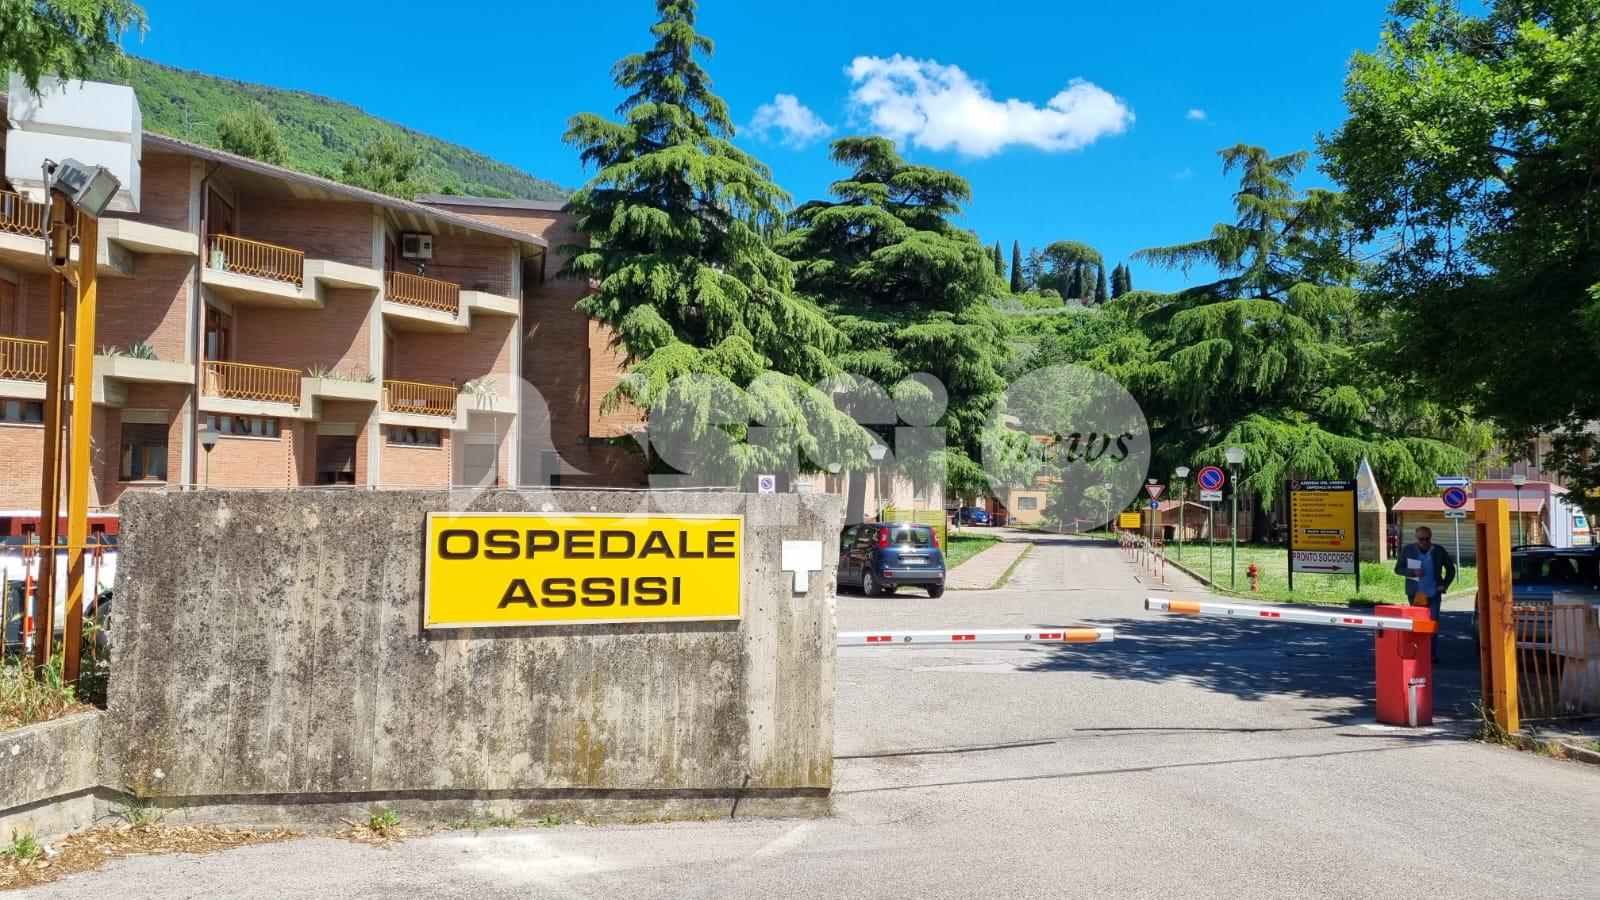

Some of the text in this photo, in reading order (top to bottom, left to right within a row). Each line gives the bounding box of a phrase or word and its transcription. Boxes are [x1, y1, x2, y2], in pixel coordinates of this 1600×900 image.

[437, 529, 736, 560] OSPEDALE
[1292, 552, 1354, 563] PRONTO SOCCORSO
[496, 576, 681, 609] ASSISI
